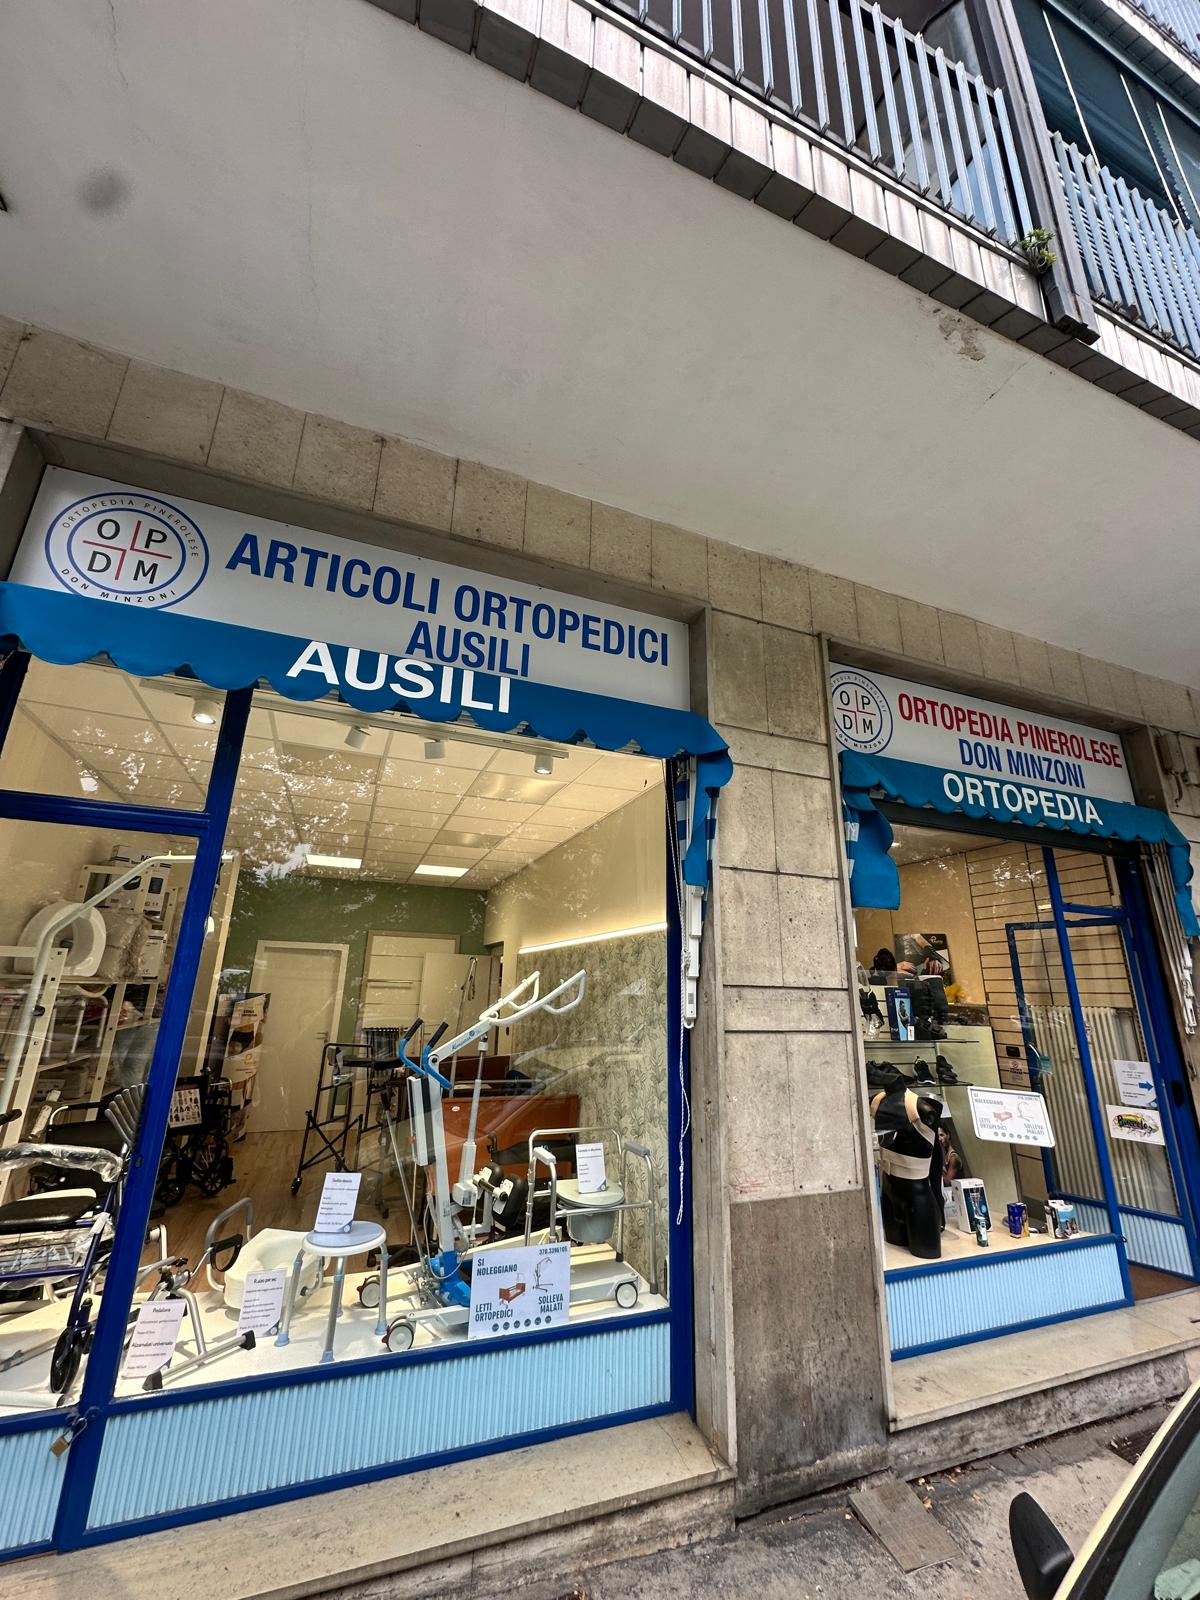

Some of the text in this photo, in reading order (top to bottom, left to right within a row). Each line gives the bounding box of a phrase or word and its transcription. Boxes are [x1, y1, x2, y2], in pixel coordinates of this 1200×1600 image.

[62, 499, 199, 557] ORTOPEDIA PINEROLESE
[61, 568, 176, 603] DON MINZONI
[225, 532, 669, 667] ARTICOLI ORTOPEDICI
[405, 620, 531, 678] AUSILI
[286, 640, 511, 714] AUSILI
[853, 738, 885, 750] MINZONI
[898, 692, 1123, 769] ORTOPEDIA PINEROLESE
[959, 738, 1086, 789] DON MINZONI
[943, 772, 1104, 826] ORTOPEDIA
[476, 1264, 518, 1276] NOLEGGIANO
[477, 1258, 485, 1267] SI
[475, 1302, 492, 1313] LETTI
[475, 1309, 513, 1322] ORTOPEDICI
[538, 1293, 564, 1305] SOLLEVA
[540, 1303, 563, 1314] MALATI
